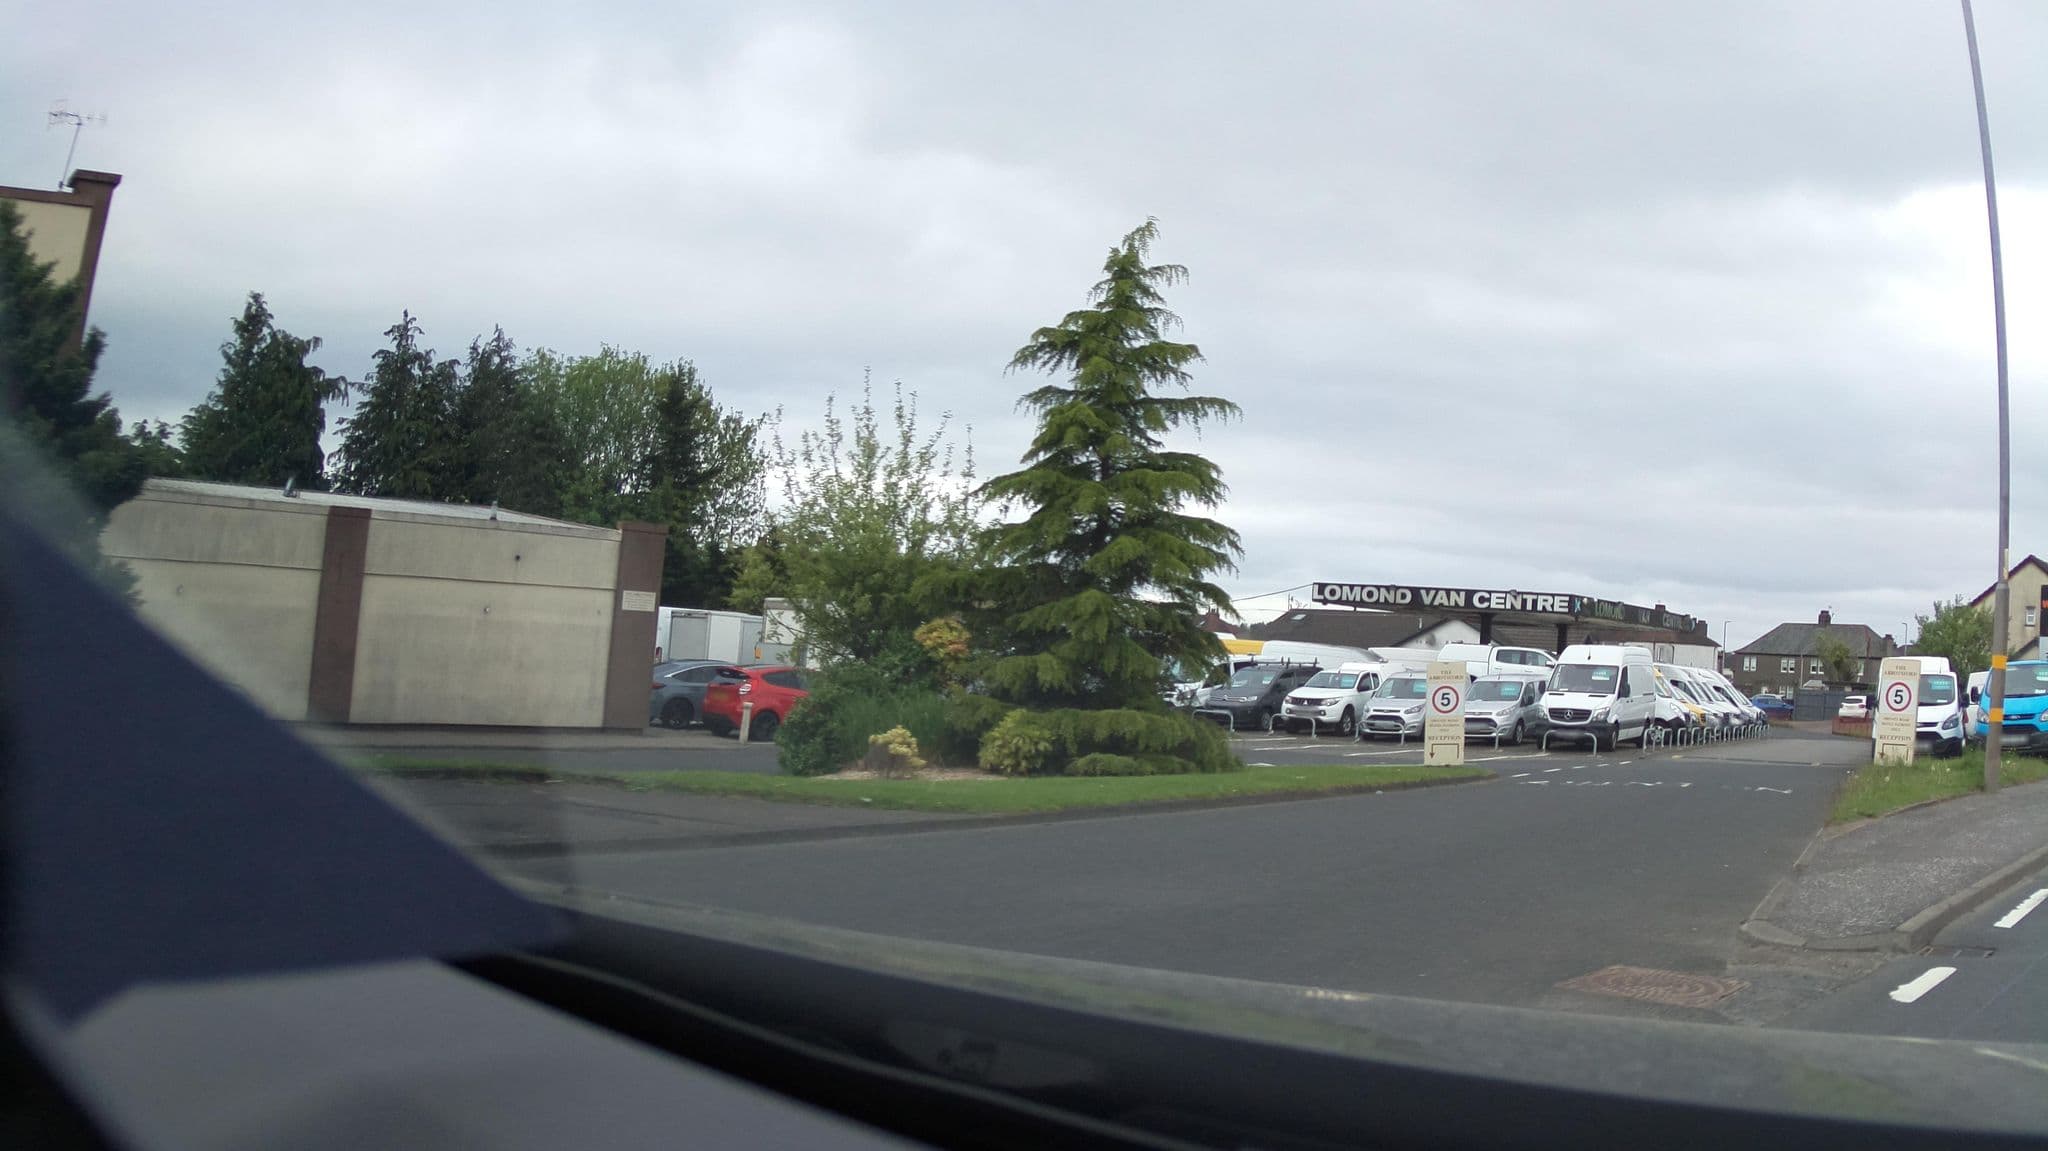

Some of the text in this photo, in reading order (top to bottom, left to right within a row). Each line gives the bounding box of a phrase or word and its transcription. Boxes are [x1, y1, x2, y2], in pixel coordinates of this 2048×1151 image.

[1312, 584, 1570, 613] LOMOND VAN CENTRE
[1440, 692, 1451, 707] 5
[1894, 689, 1903, 704] 5
